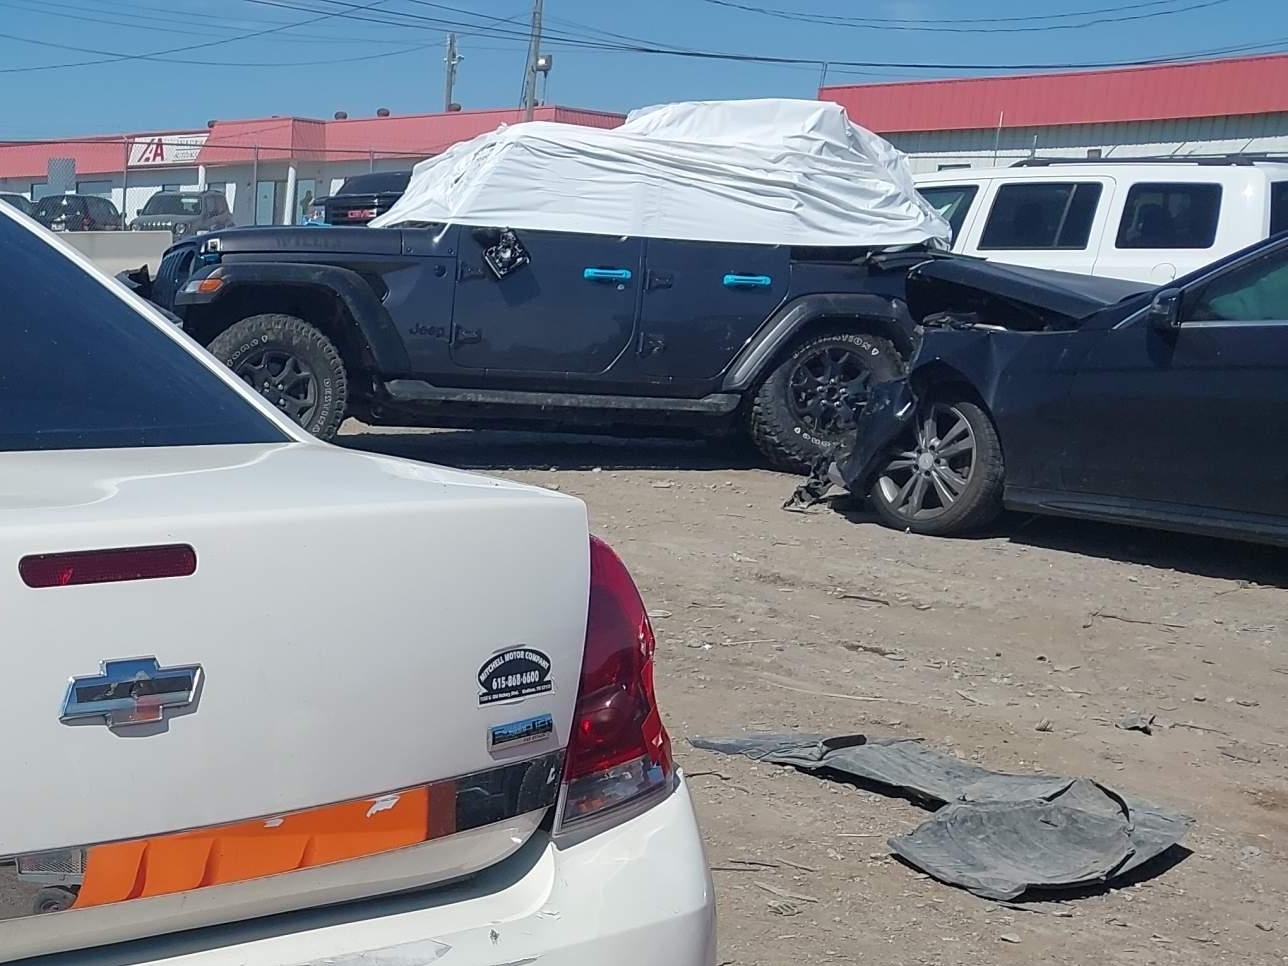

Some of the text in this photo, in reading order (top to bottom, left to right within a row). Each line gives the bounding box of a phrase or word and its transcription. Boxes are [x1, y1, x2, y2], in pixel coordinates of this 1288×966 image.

[347, 208, 377, 218] GMC
[408, 322, 447, 339] Jeep
[479, 650, 550, 683] MITCHELL MOTOR COMPANY
